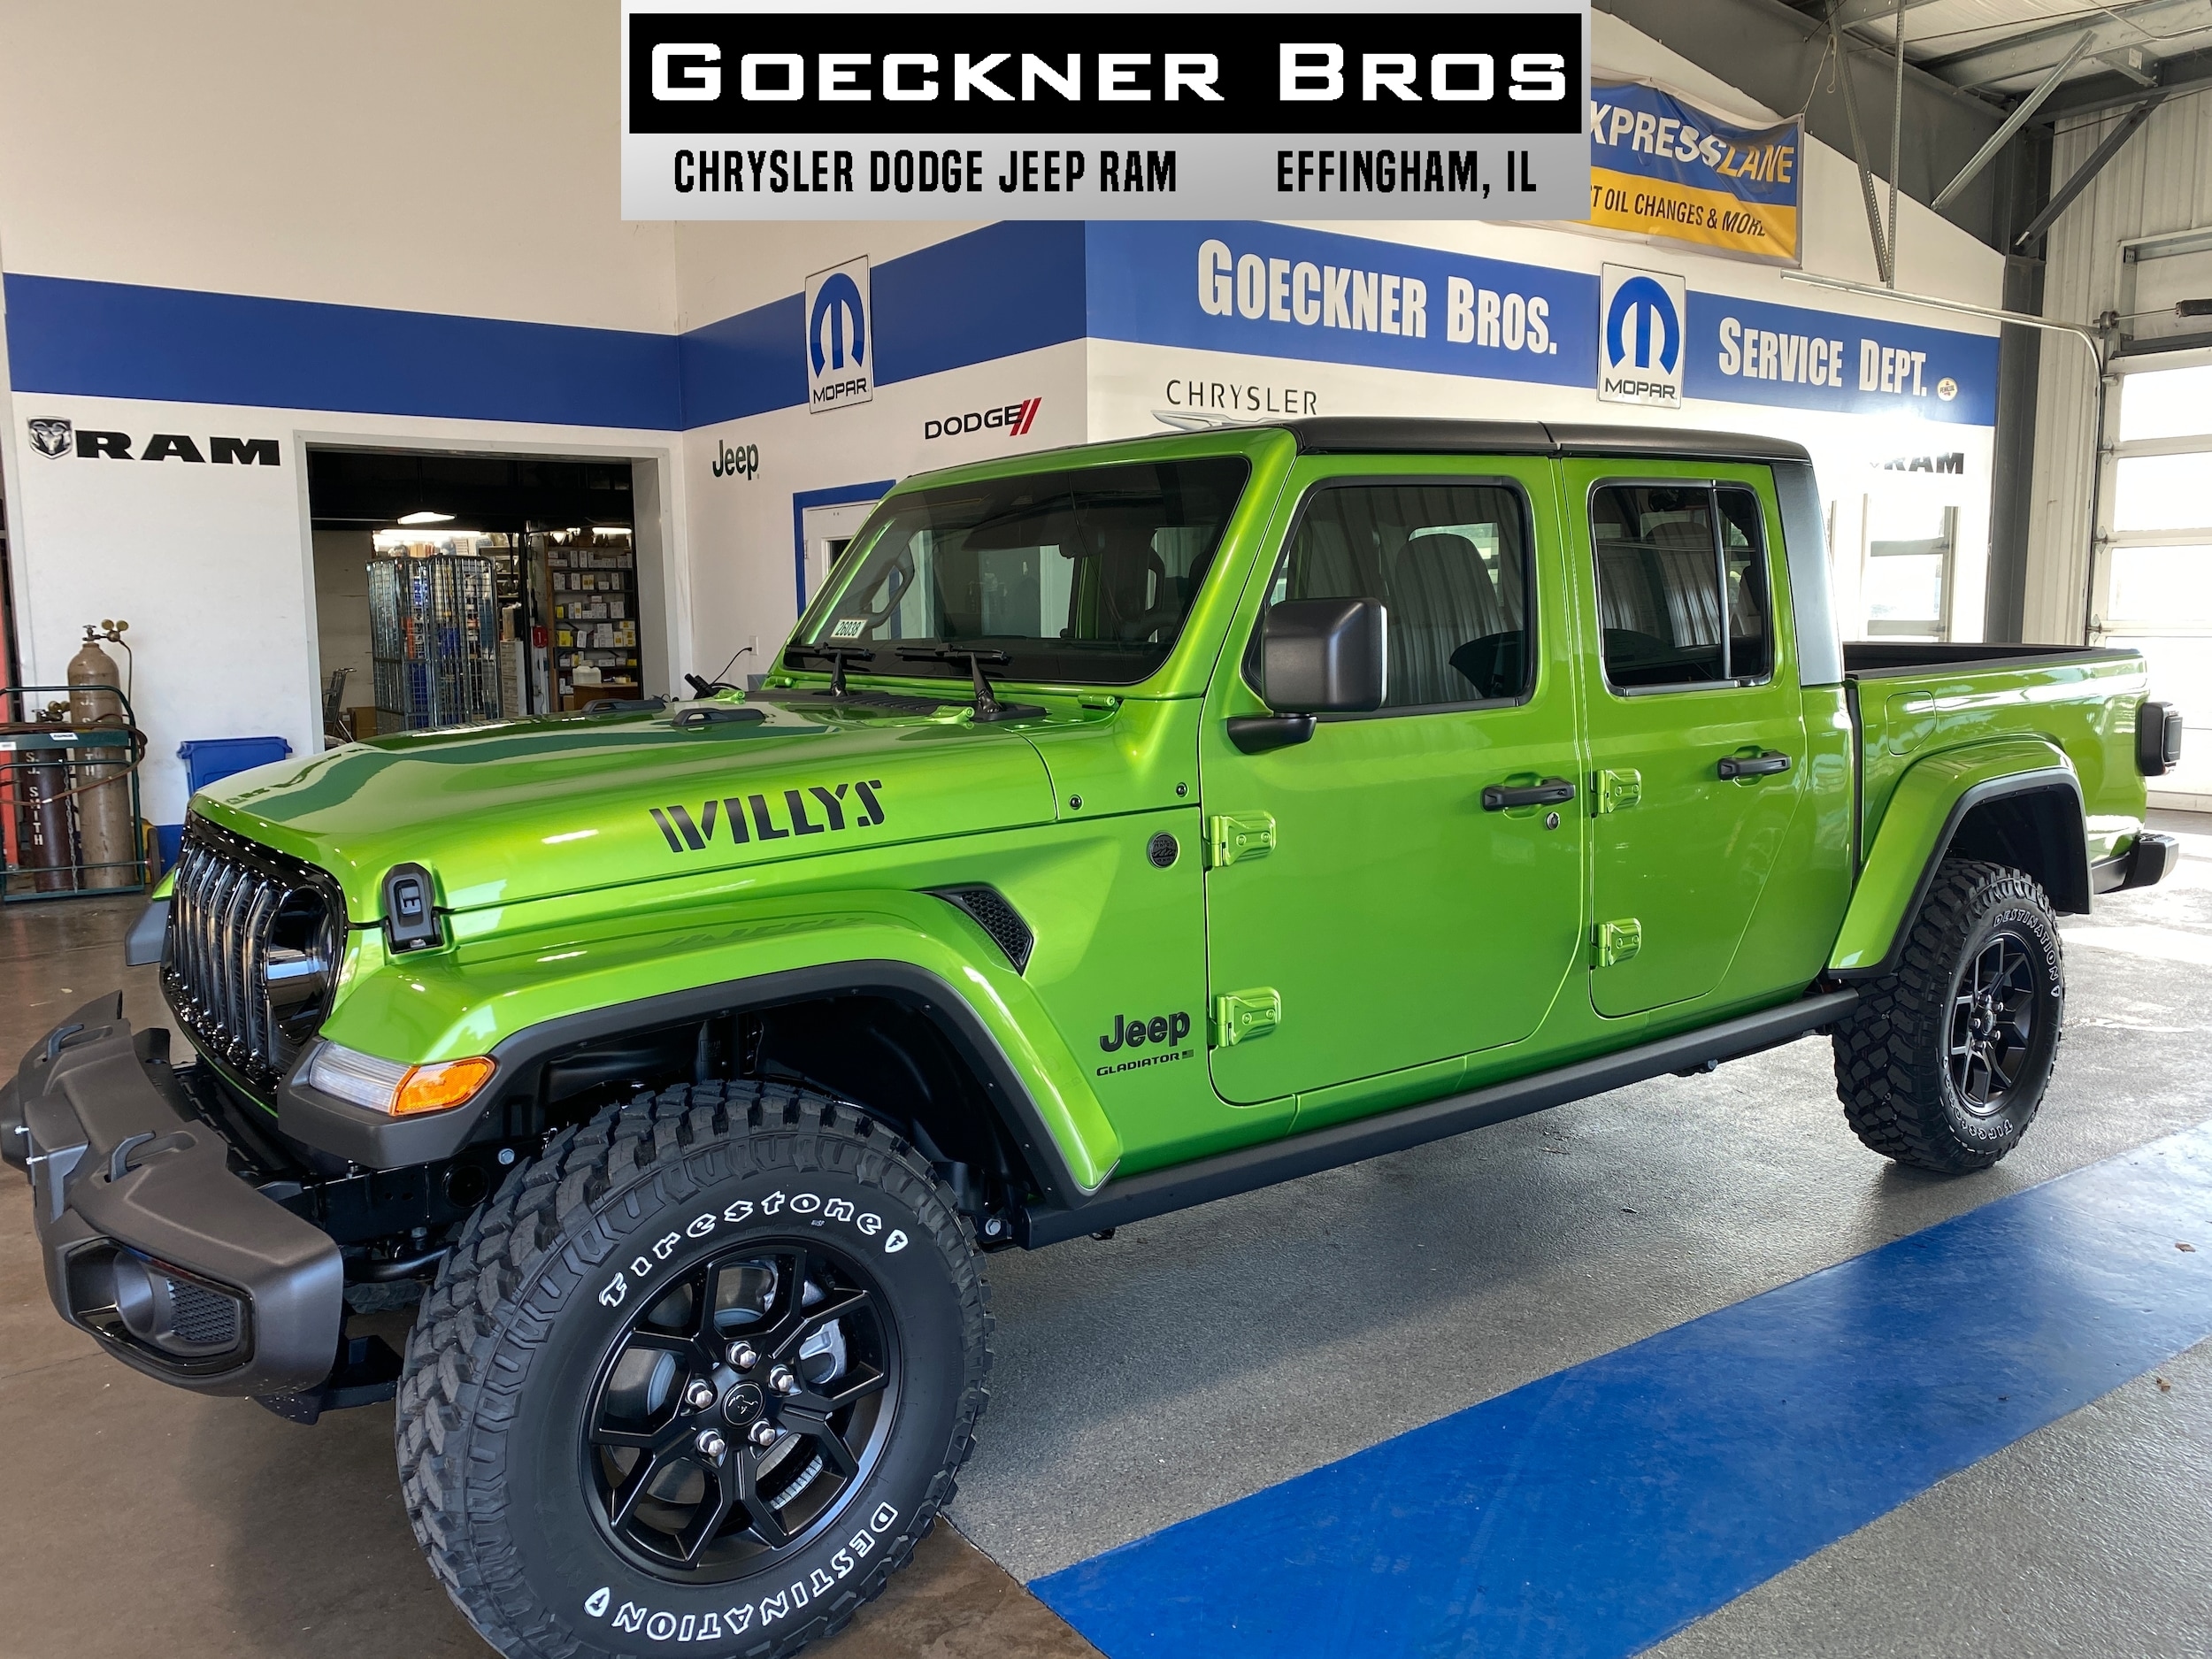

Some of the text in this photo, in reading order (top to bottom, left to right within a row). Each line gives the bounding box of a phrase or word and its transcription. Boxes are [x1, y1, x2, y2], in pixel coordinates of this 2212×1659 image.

[1604, 190, 1628, 213] OIL
[1634, 193, 1704, 227] CHANGES
[1707, 208, 1717, 229] &
[1198, 239, 1557, 355] GOECKNER BROS.
[1718, 317, 1927, 397] SERVICE DEPT.
[812, 377, 867, 404] MOPAR
[1166, 379, 1317, 415] CHRYSLER
[1605, 377, 1676, 400] MOPAR
[925, 403, 1023, 440] DODGE
[74, 429, 280, 466] RAM
[712, 439, 759, 480] Jeep
[649, 780, 885, 853] WILLYS
[1993, 908, 2059, 981] DESTINATION
[1099, 1011, 1190, 1053] Jeep
[1096, 1052, 1180, 1077] GLADIATOR
[598, 1190, 883, 1308] Firestone
[611, 1502, 899, 1642] DESTINATION
